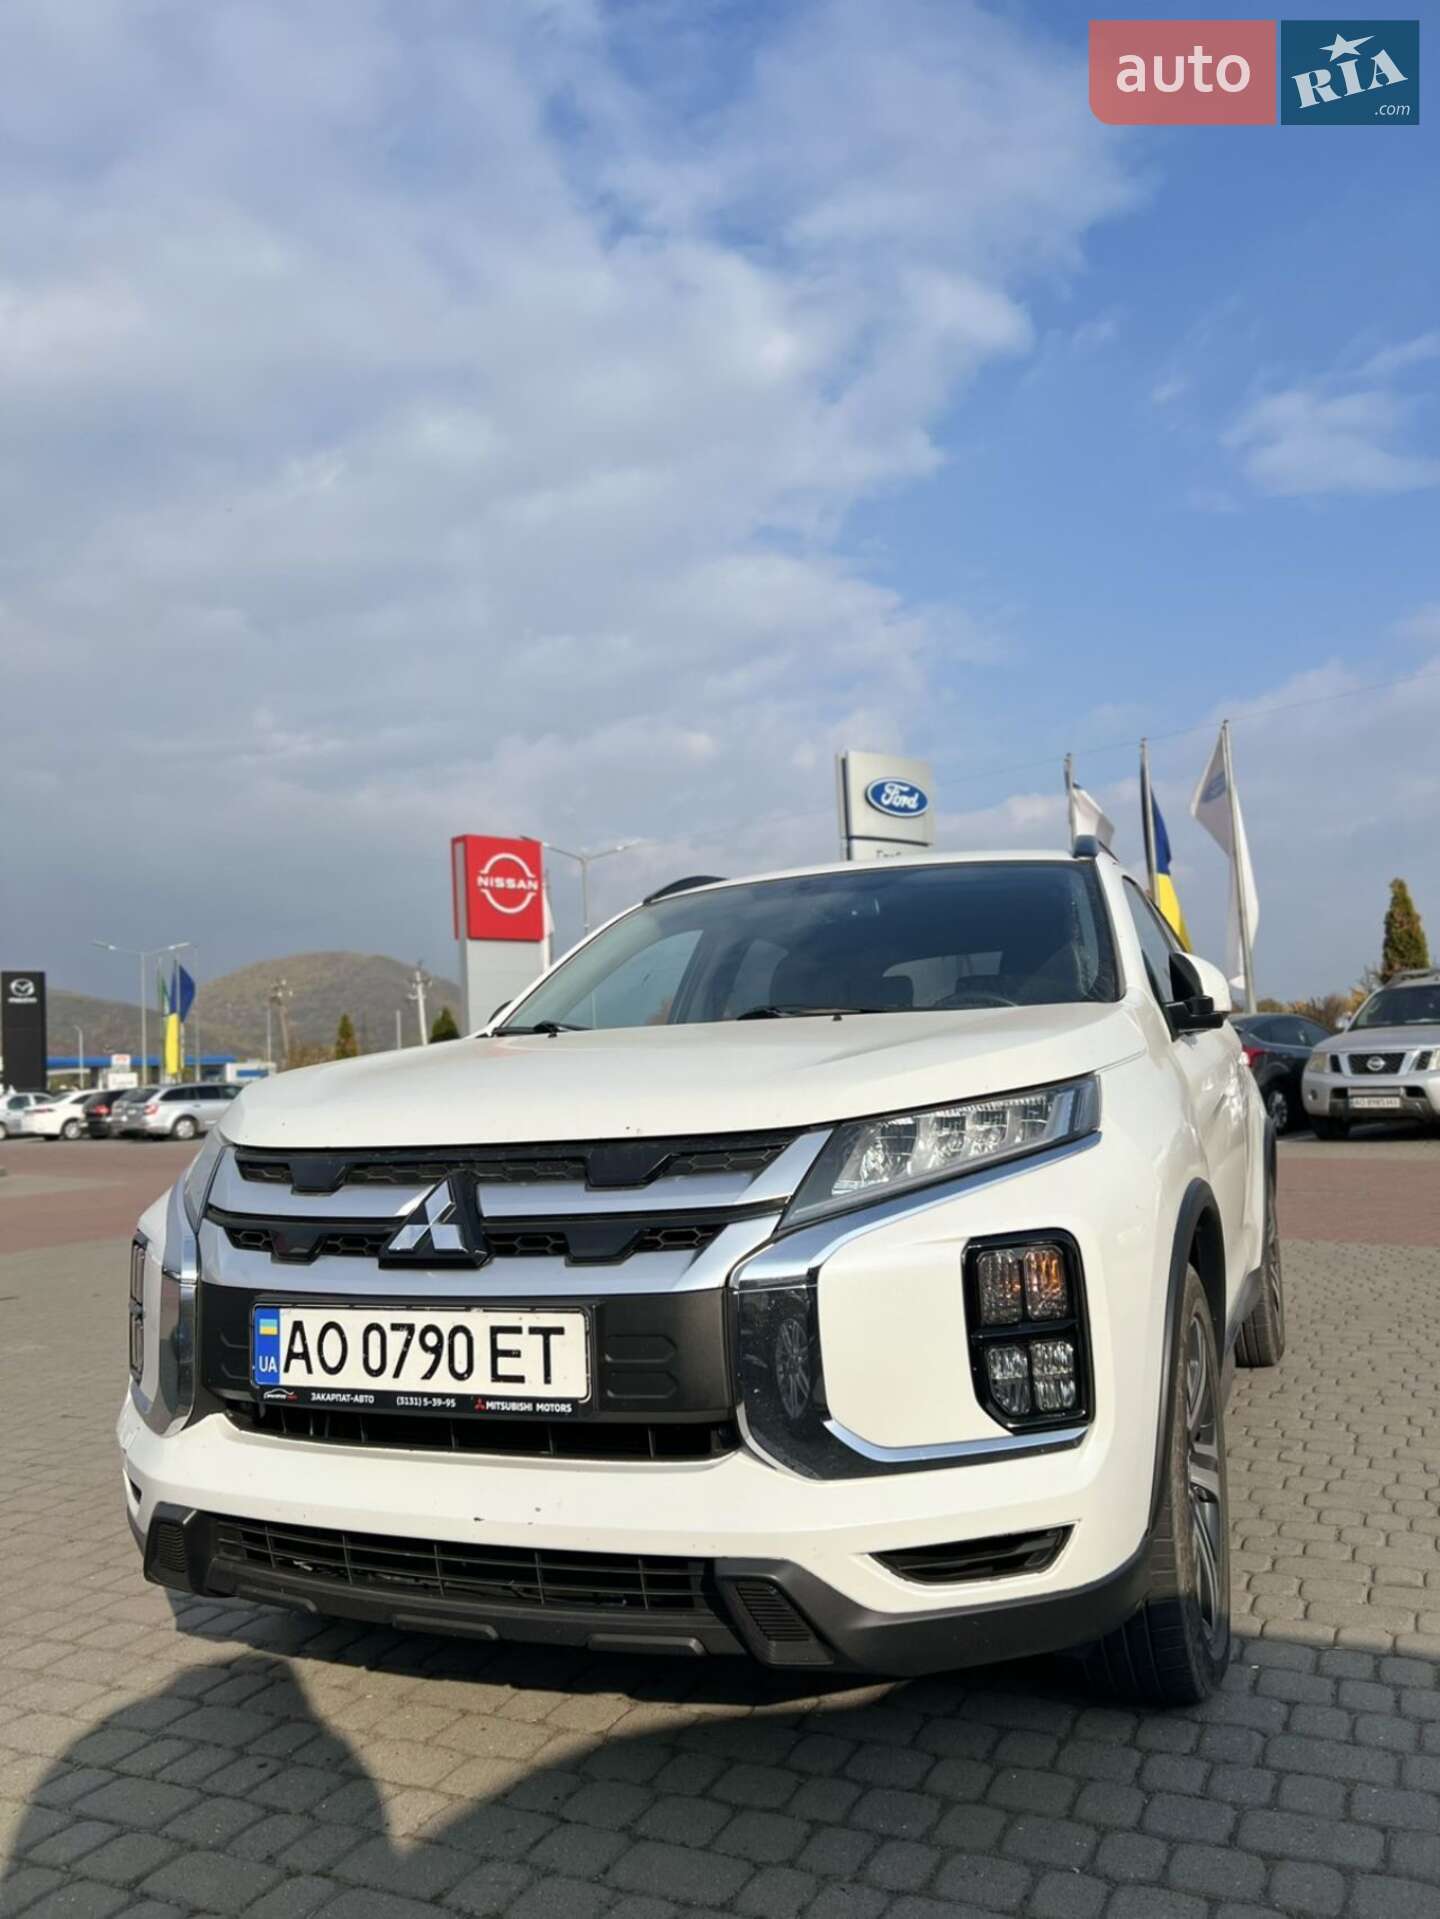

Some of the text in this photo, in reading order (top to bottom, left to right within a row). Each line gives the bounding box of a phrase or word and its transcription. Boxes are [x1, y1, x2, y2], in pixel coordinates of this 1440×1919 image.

[881, 783, 919, 809] Ford
[477, 876, 538, 890] NISSAN
[283, 1320, 565, 1385] AO 0790 ET
[259, 1355, 278, 1373] UA
[310, 1392, 375, 1404] ЗАКАРПАТ-АВТО
[486, 1401, 572, 1414] MITSUBISHI MOTORS
